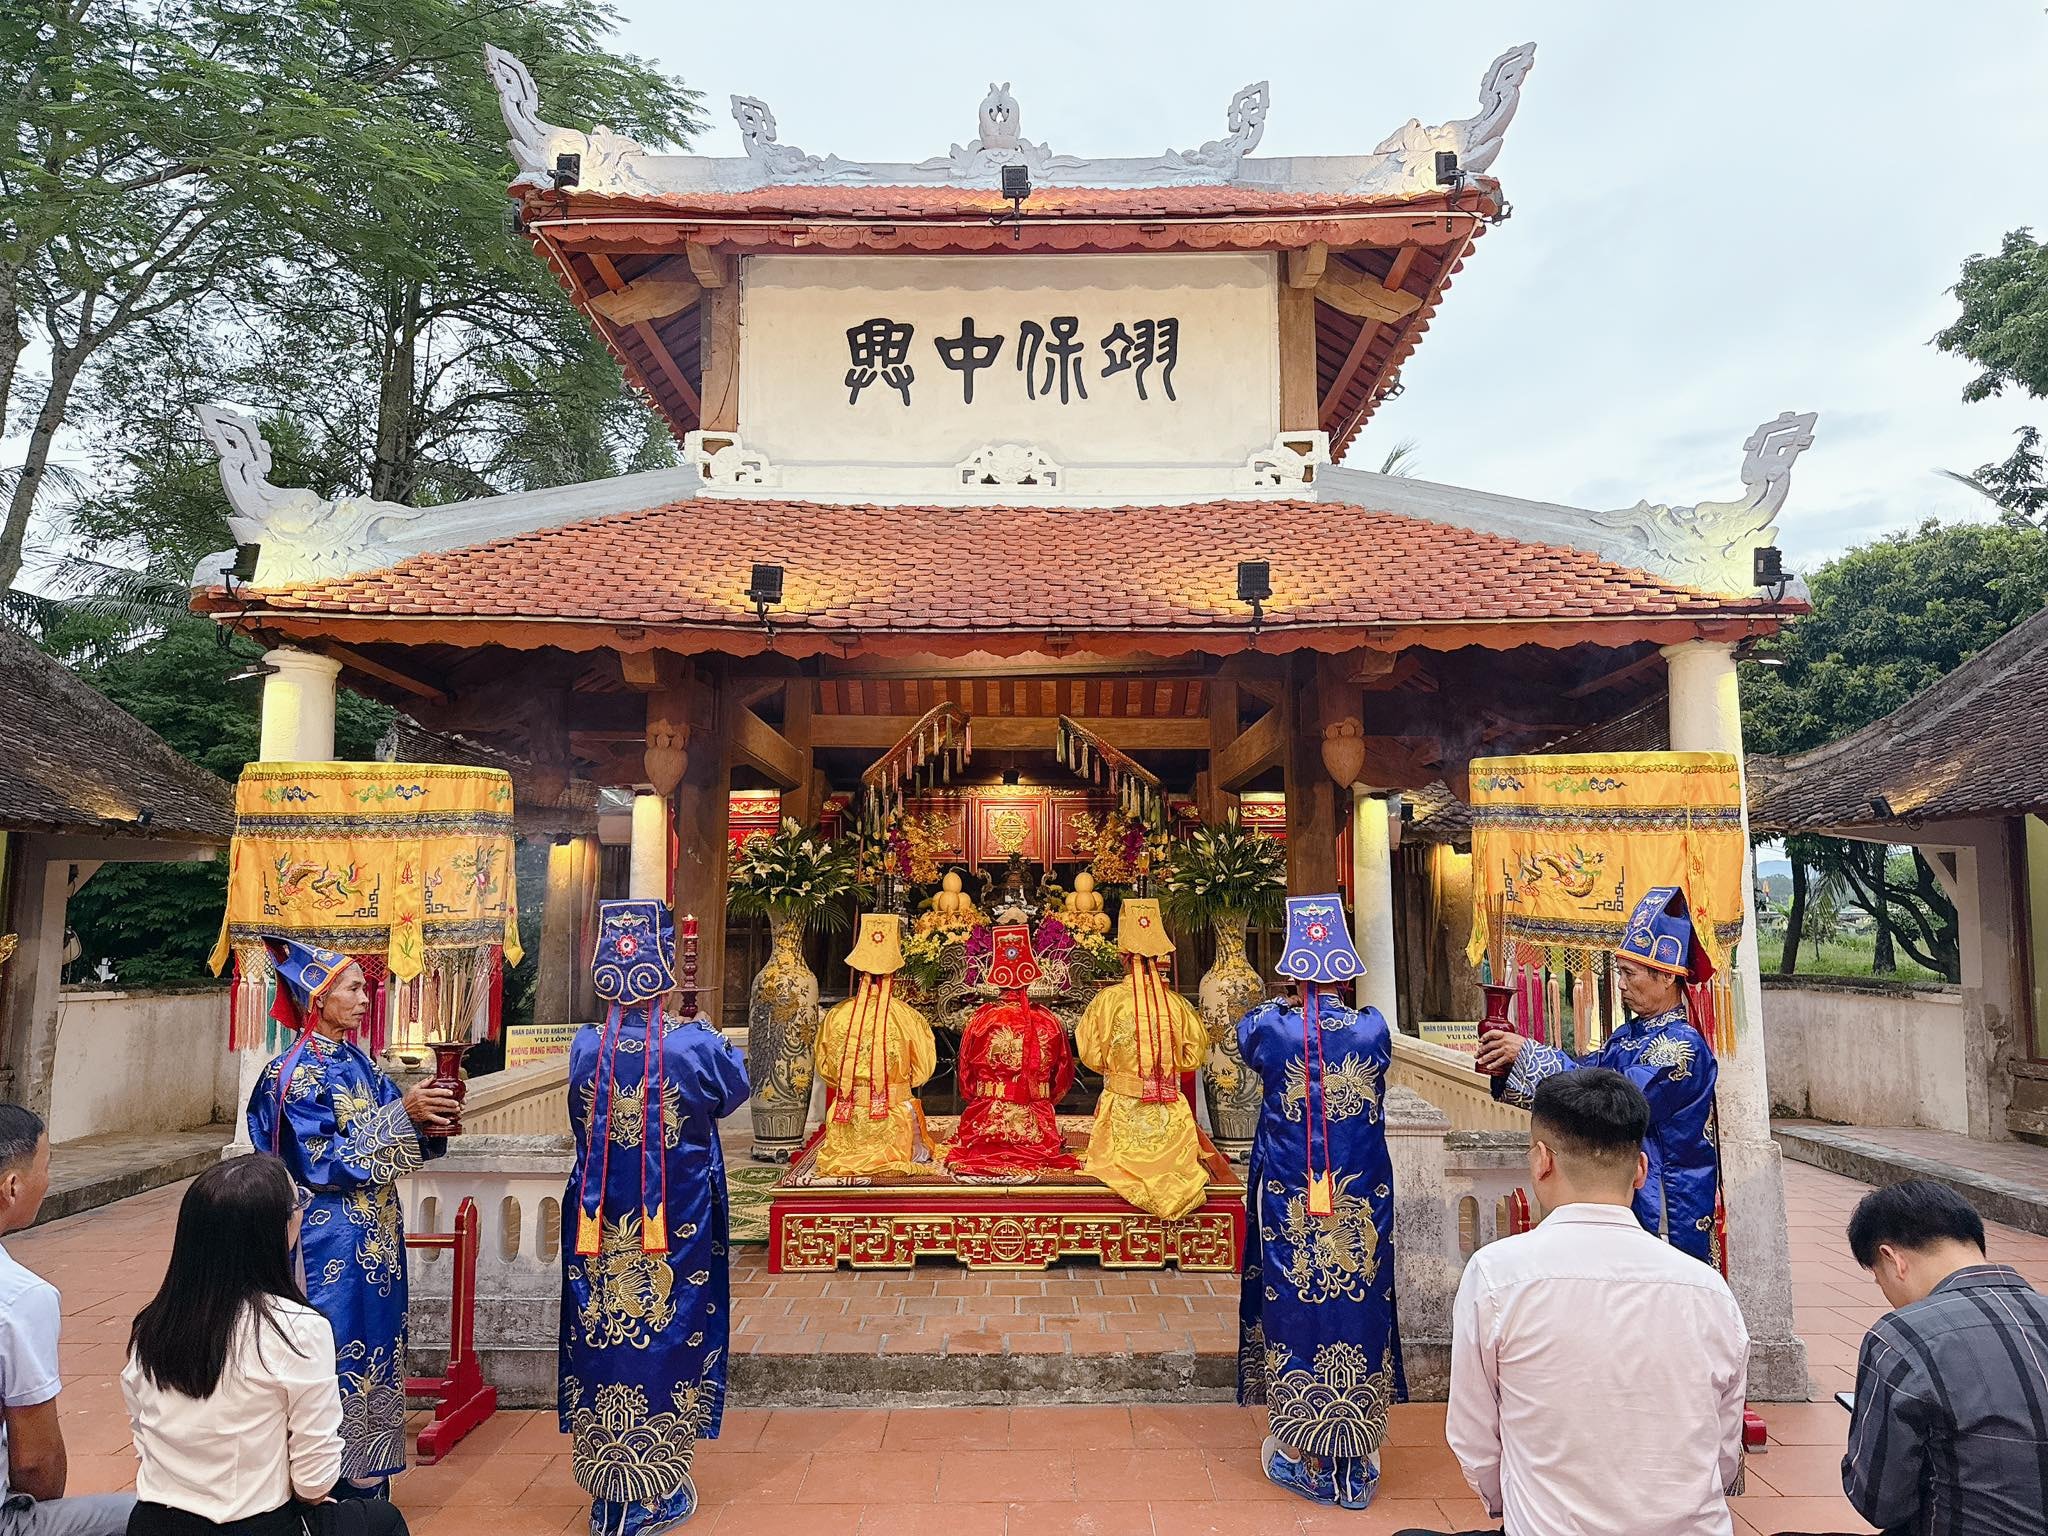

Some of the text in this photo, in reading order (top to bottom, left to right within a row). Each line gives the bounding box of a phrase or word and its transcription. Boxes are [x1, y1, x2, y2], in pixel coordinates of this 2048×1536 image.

[550, 1035, 573, 1043] LÒNG
[511, 1046, 529, 1055] KHÔNG
[529, 1046, 545, 1055] MANG
